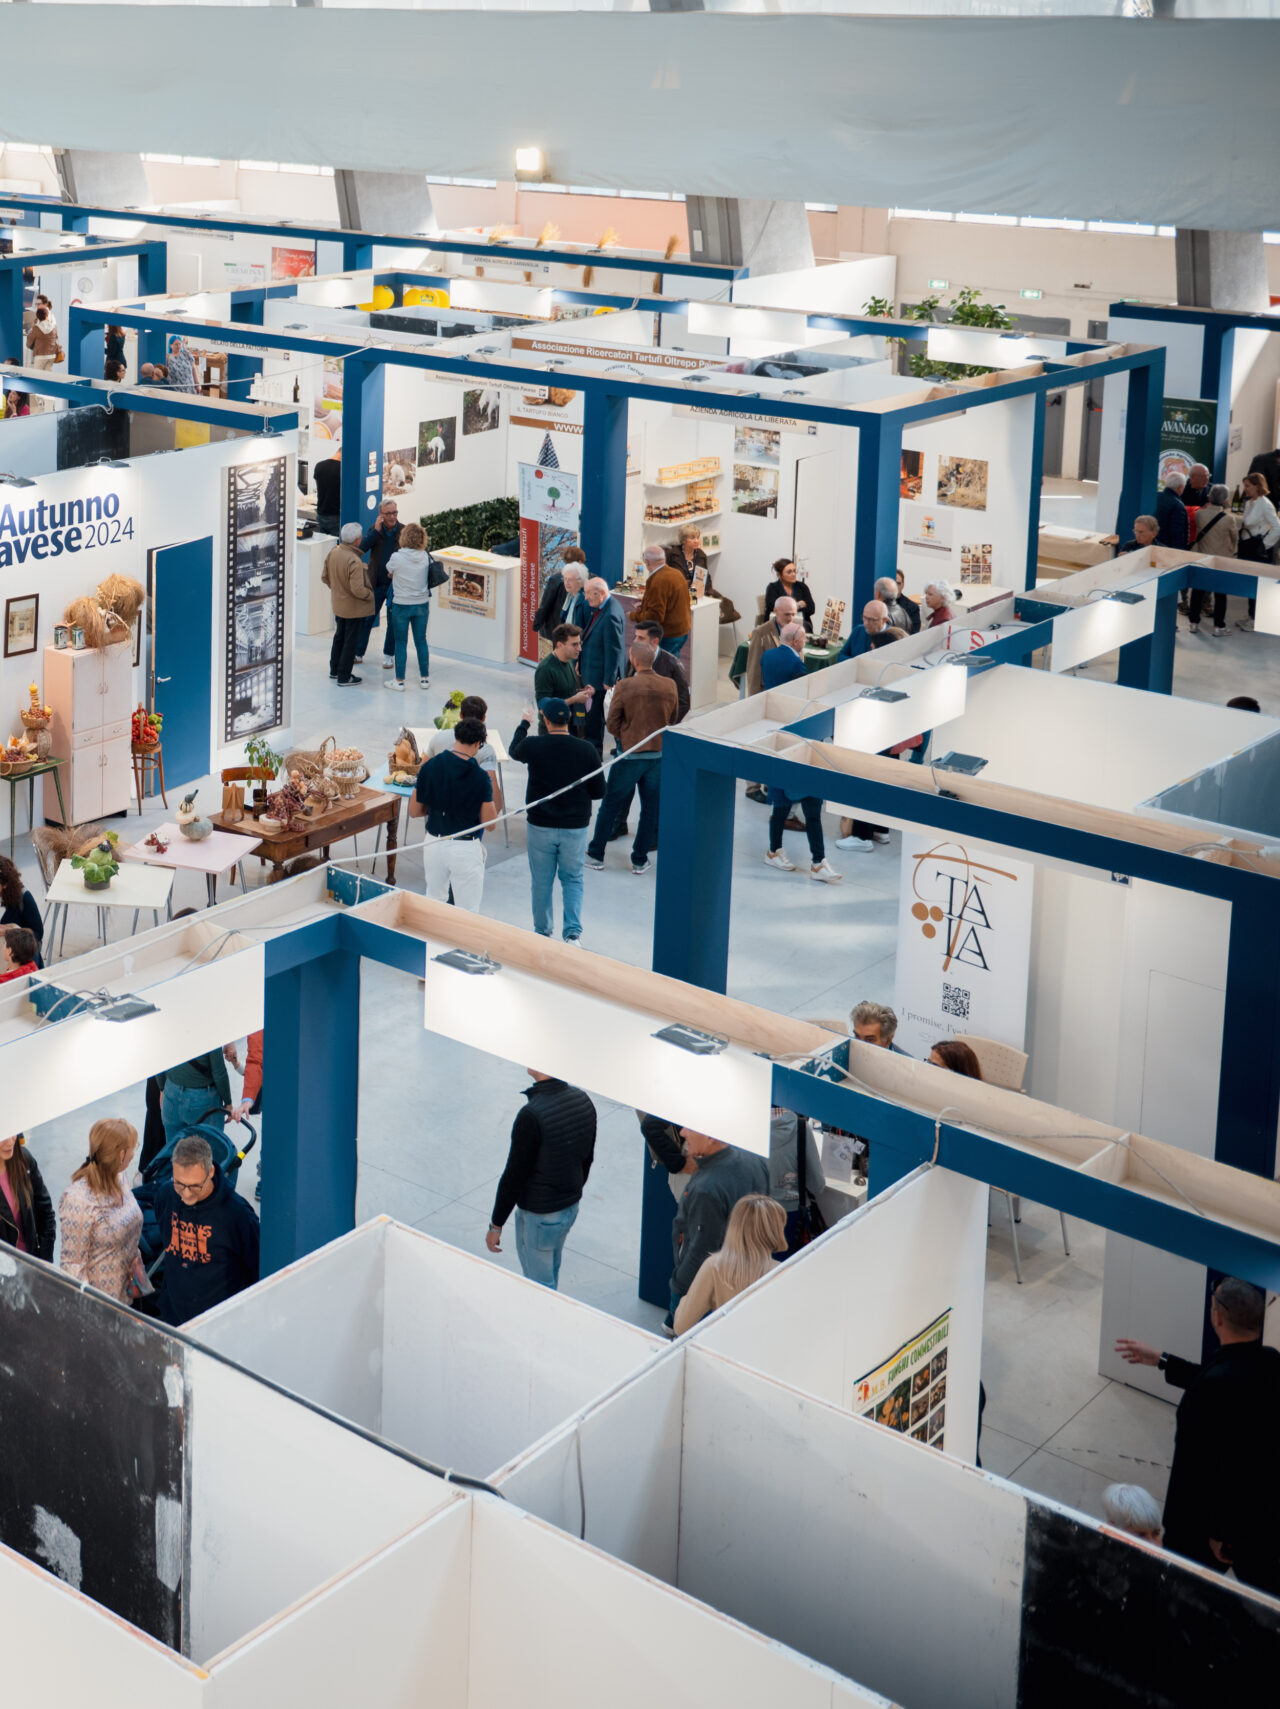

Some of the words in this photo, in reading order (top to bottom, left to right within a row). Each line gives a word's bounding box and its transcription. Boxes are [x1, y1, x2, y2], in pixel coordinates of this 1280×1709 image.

[531, 340, 585, 356] Associazione
[586, 346, 633, 361] Ricercatori
[635, 352, 662, 364] Tartufi
[523, 408, 546, 416] TARTUFO
[690, 405, 717, 416] AZIENDA
[719, 410, 753, 420] AGRICOLA
[764, 415, 797, 426] LIBERATA
[85, 517, 135, 549] 2024
[907, 1010, 945, 1033] promise,
[888, 1355, 909, 1384] FUNGHI
[910, 1322, 949, 1365] COMMESTIBILI
